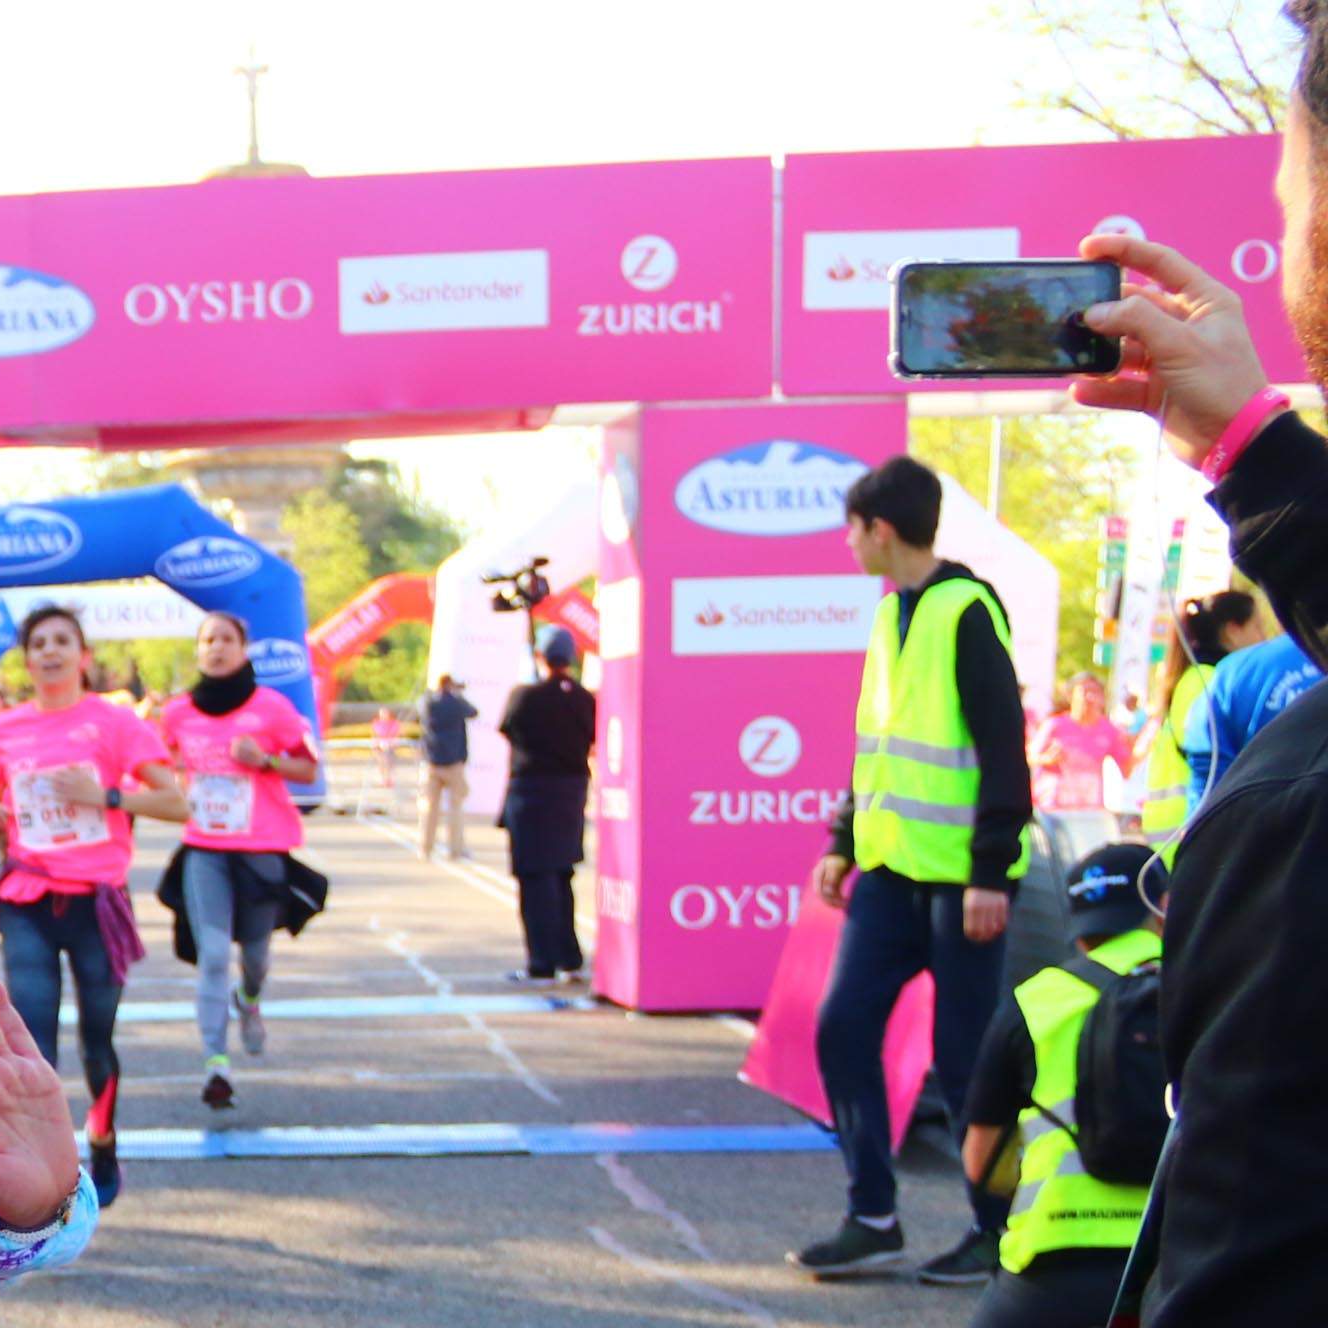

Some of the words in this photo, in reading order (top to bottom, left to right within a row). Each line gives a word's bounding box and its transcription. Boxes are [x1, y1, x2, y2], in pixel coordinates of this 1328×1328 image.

[123, 277, 314, 326] OYSHO
[395, 279, 525, 305] Santander
[577, 301, 723, 337] ZURICH
[690, 477, 847, 512] ASTURIAN
[730, 602, 860, 627] Santander
[689, 788, 852, 825] ZURICH
[669, 883, 801, 930] OYS
